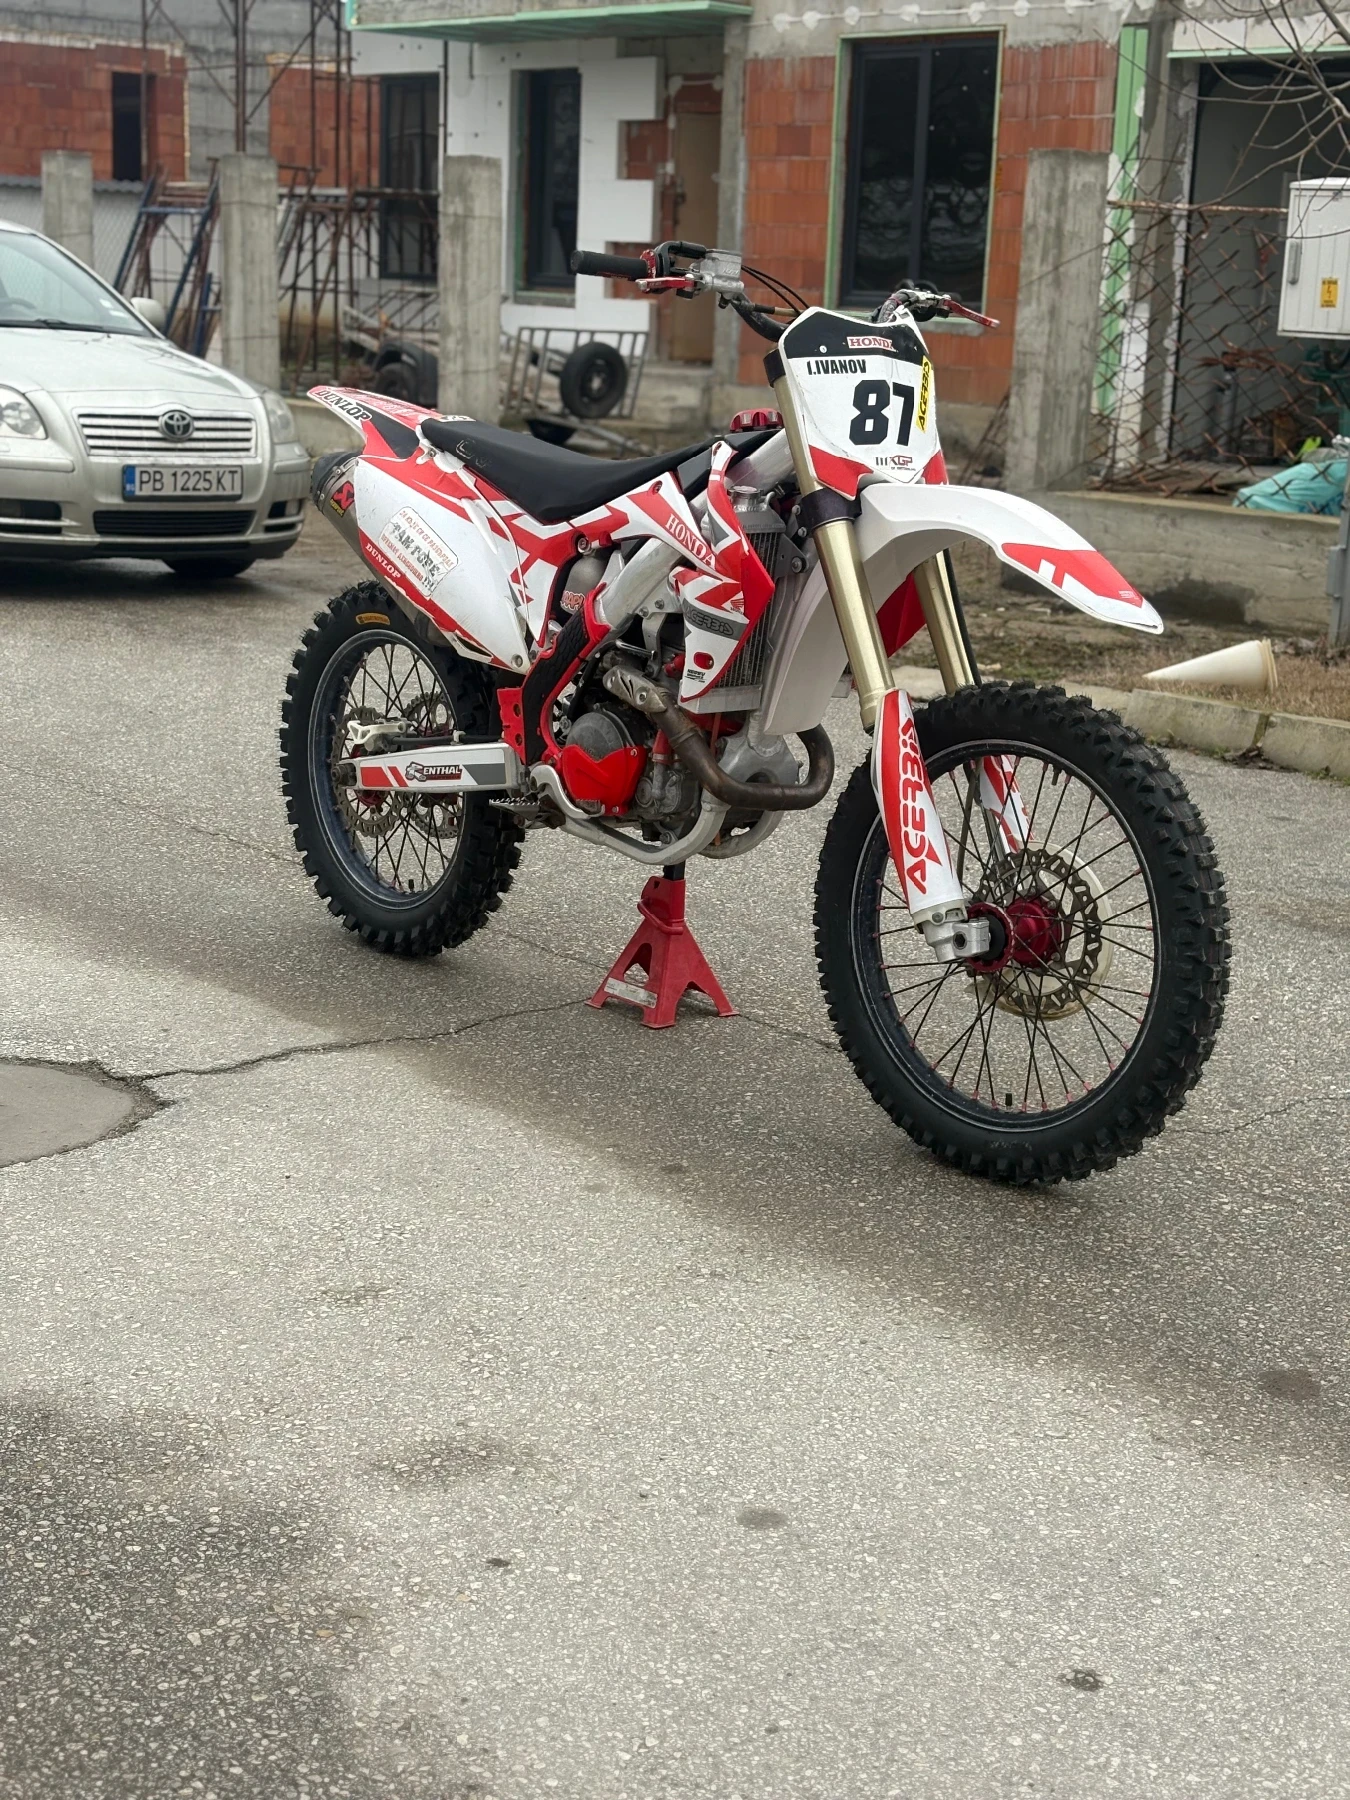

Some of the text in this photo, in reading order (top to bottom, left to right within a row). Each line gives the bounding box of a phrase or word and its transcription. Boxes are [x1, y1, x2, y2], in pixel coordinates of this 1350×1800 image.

[806, 359, 867, 376] I.IVANOV
[315, 389, 372, 421] DUNLOP
[849, 379, 915, 447] 87
[139, 470, 239, 492] PB 1225 KT
[665, 513, 716, 571] HONDA
[365, 542, 402, 578] DUNLOP
